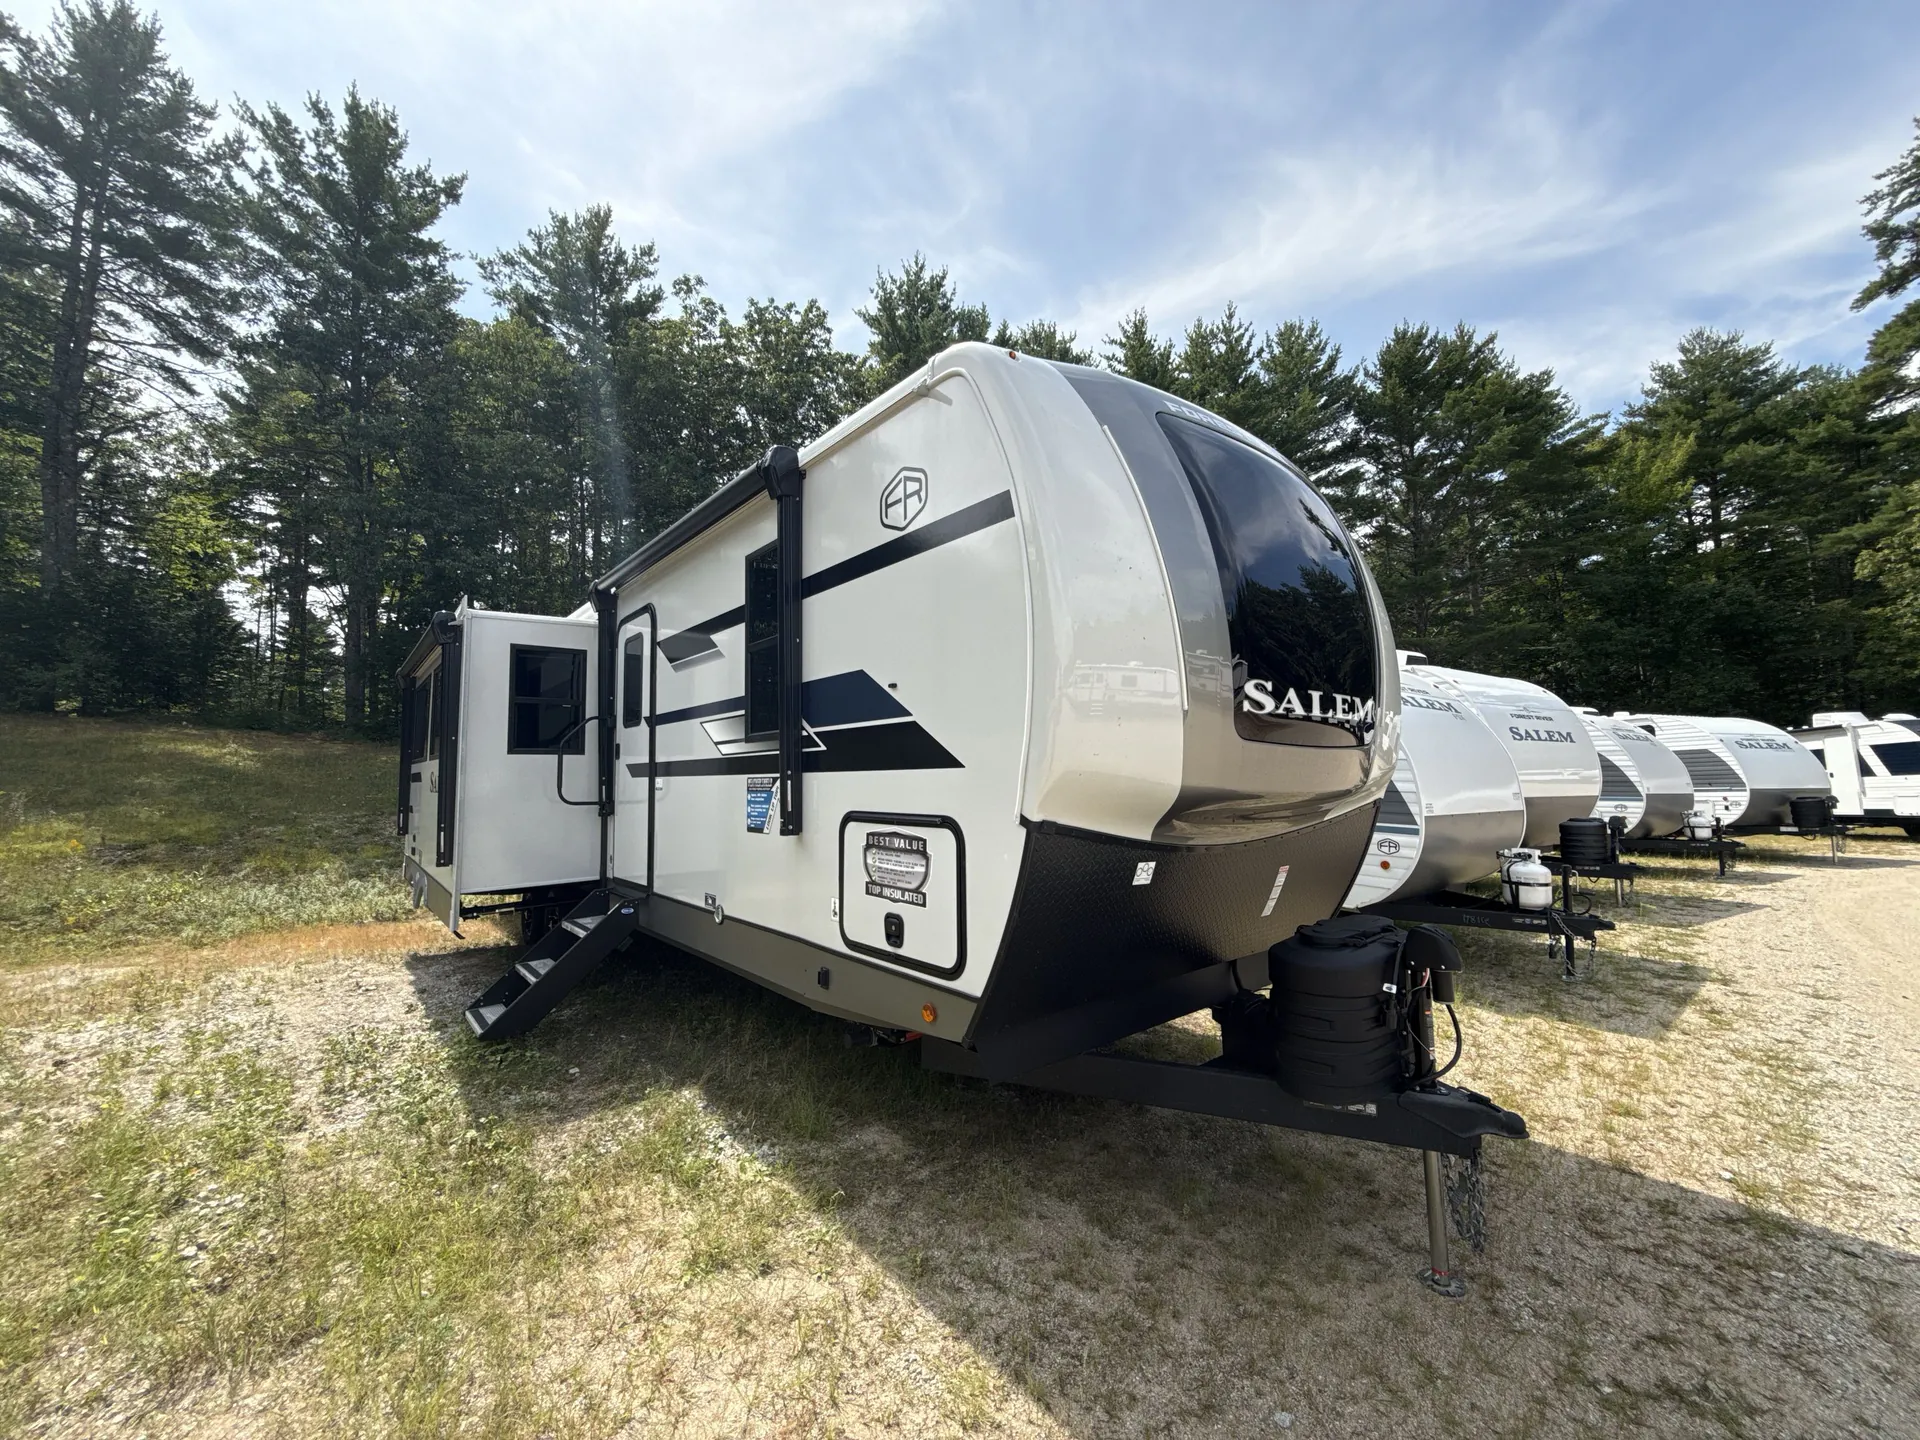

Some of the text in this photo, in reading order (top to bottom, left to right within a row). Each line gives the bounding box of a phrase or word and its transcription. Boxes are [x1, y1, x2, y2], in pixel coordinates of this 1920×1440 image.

[884, 475, 923, 522] FR
[1242, 678, 1376, 724] SALEM
[1400, 695, 1462, 714] ALEM
[1508, 726, 1576, 743] SALEM
[1734, 740, 1793, 750] SALEM
[868, 835, 924, 851] BEST VALUE
[867, 884, 924, 905] TOP INSULATED
